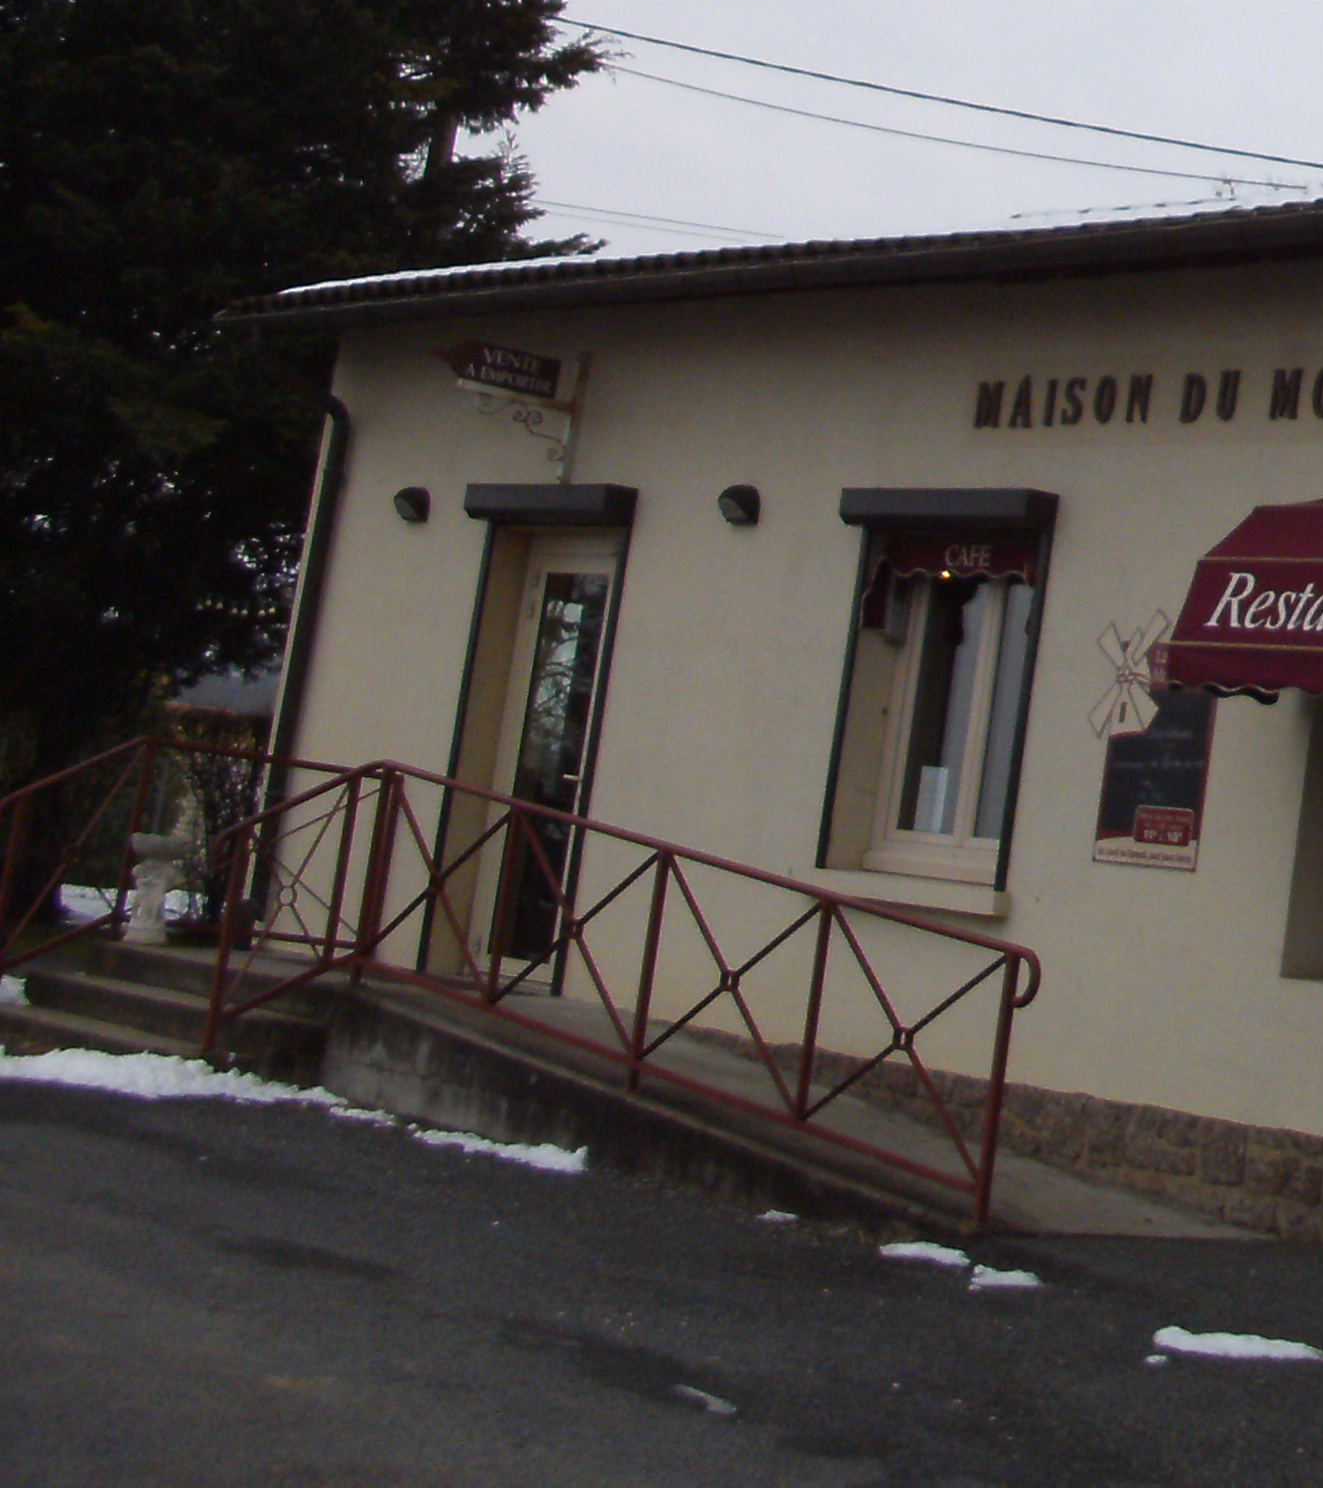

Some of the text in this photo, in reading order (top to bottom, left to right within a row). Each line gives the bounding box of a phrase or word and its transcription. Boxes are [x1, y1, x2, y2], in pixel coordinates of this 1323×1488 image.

[483, 347, 540, 374] VENTE
[973, 372, 1154, 429] MAISON
[1178, 369, 1242, 424] DU
